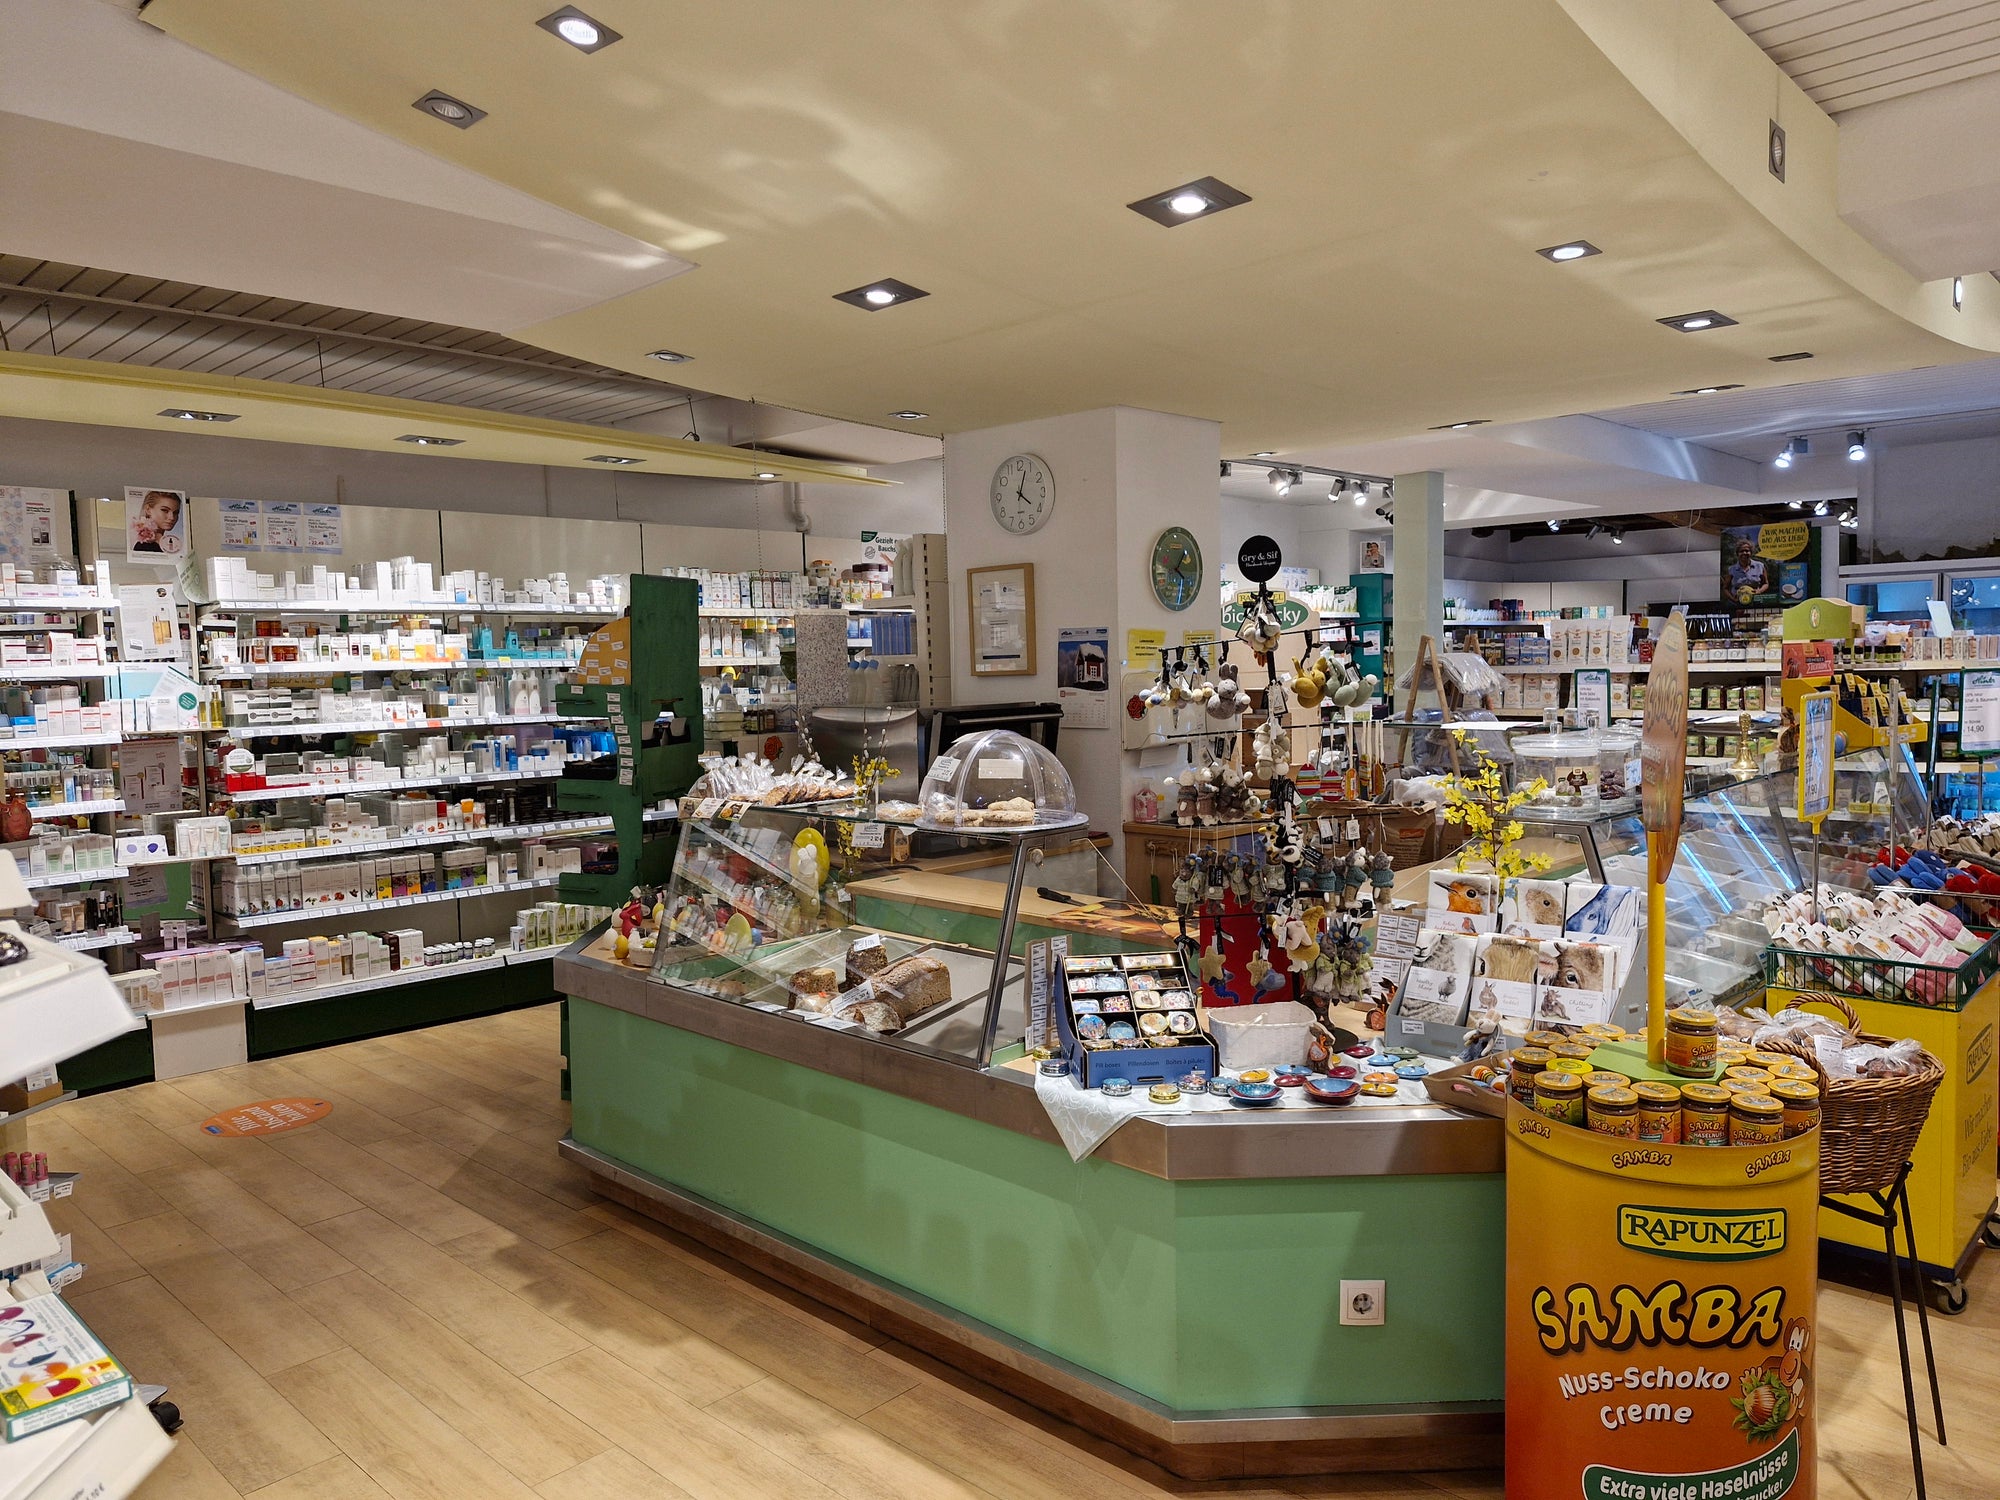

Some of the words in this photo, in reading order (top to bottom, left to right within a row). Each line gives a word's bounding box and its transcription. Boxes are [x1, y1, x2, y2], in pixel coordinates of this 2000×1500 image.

[1006, 463, 1014, 476] 11
[1016, 459, 1024, 472] 12
[1028, 460, 1032, 473] 1
[1035, 471, 1043, 484] 2
[995, 492, 1003, 504] 9
[1040, 486, 1046, 498] 3
[1000, 506, 1007, 518] 8
[1036, 502, 1043, 513] 4
[1008, 515, 1015, 527] 7
[1018, 518, 1025, 530] 6
[1028, 513, 1035, 526] 5
[875, 536, 893, 544] Gezielt
[1241, 554, 1256, 563] Gry
[1266, 550, 1279, 559] Sif
[1518, 1118, 1552, 1139] SAMBA
[1688, 1121, 1725, 1132] SAMBA
[1732, 1129, 1771, 1143] SAMBA
[1611, 1149, 1673, 1170] SAMBA
[1745, 1149, 1792, 1179] SAMBA
[1625, 1212, 1783, 1249] RAPUNZEL
[1531, 1279, 1788, 1356] SAMBA
[1599, 1402, 1694, 1431] Creme
[1600, 1475, 1646, 1500] Extra
[1650, 1482, 1698, 1500] viele
[1701, 1450, 1788, 1499] Haselnüsse
